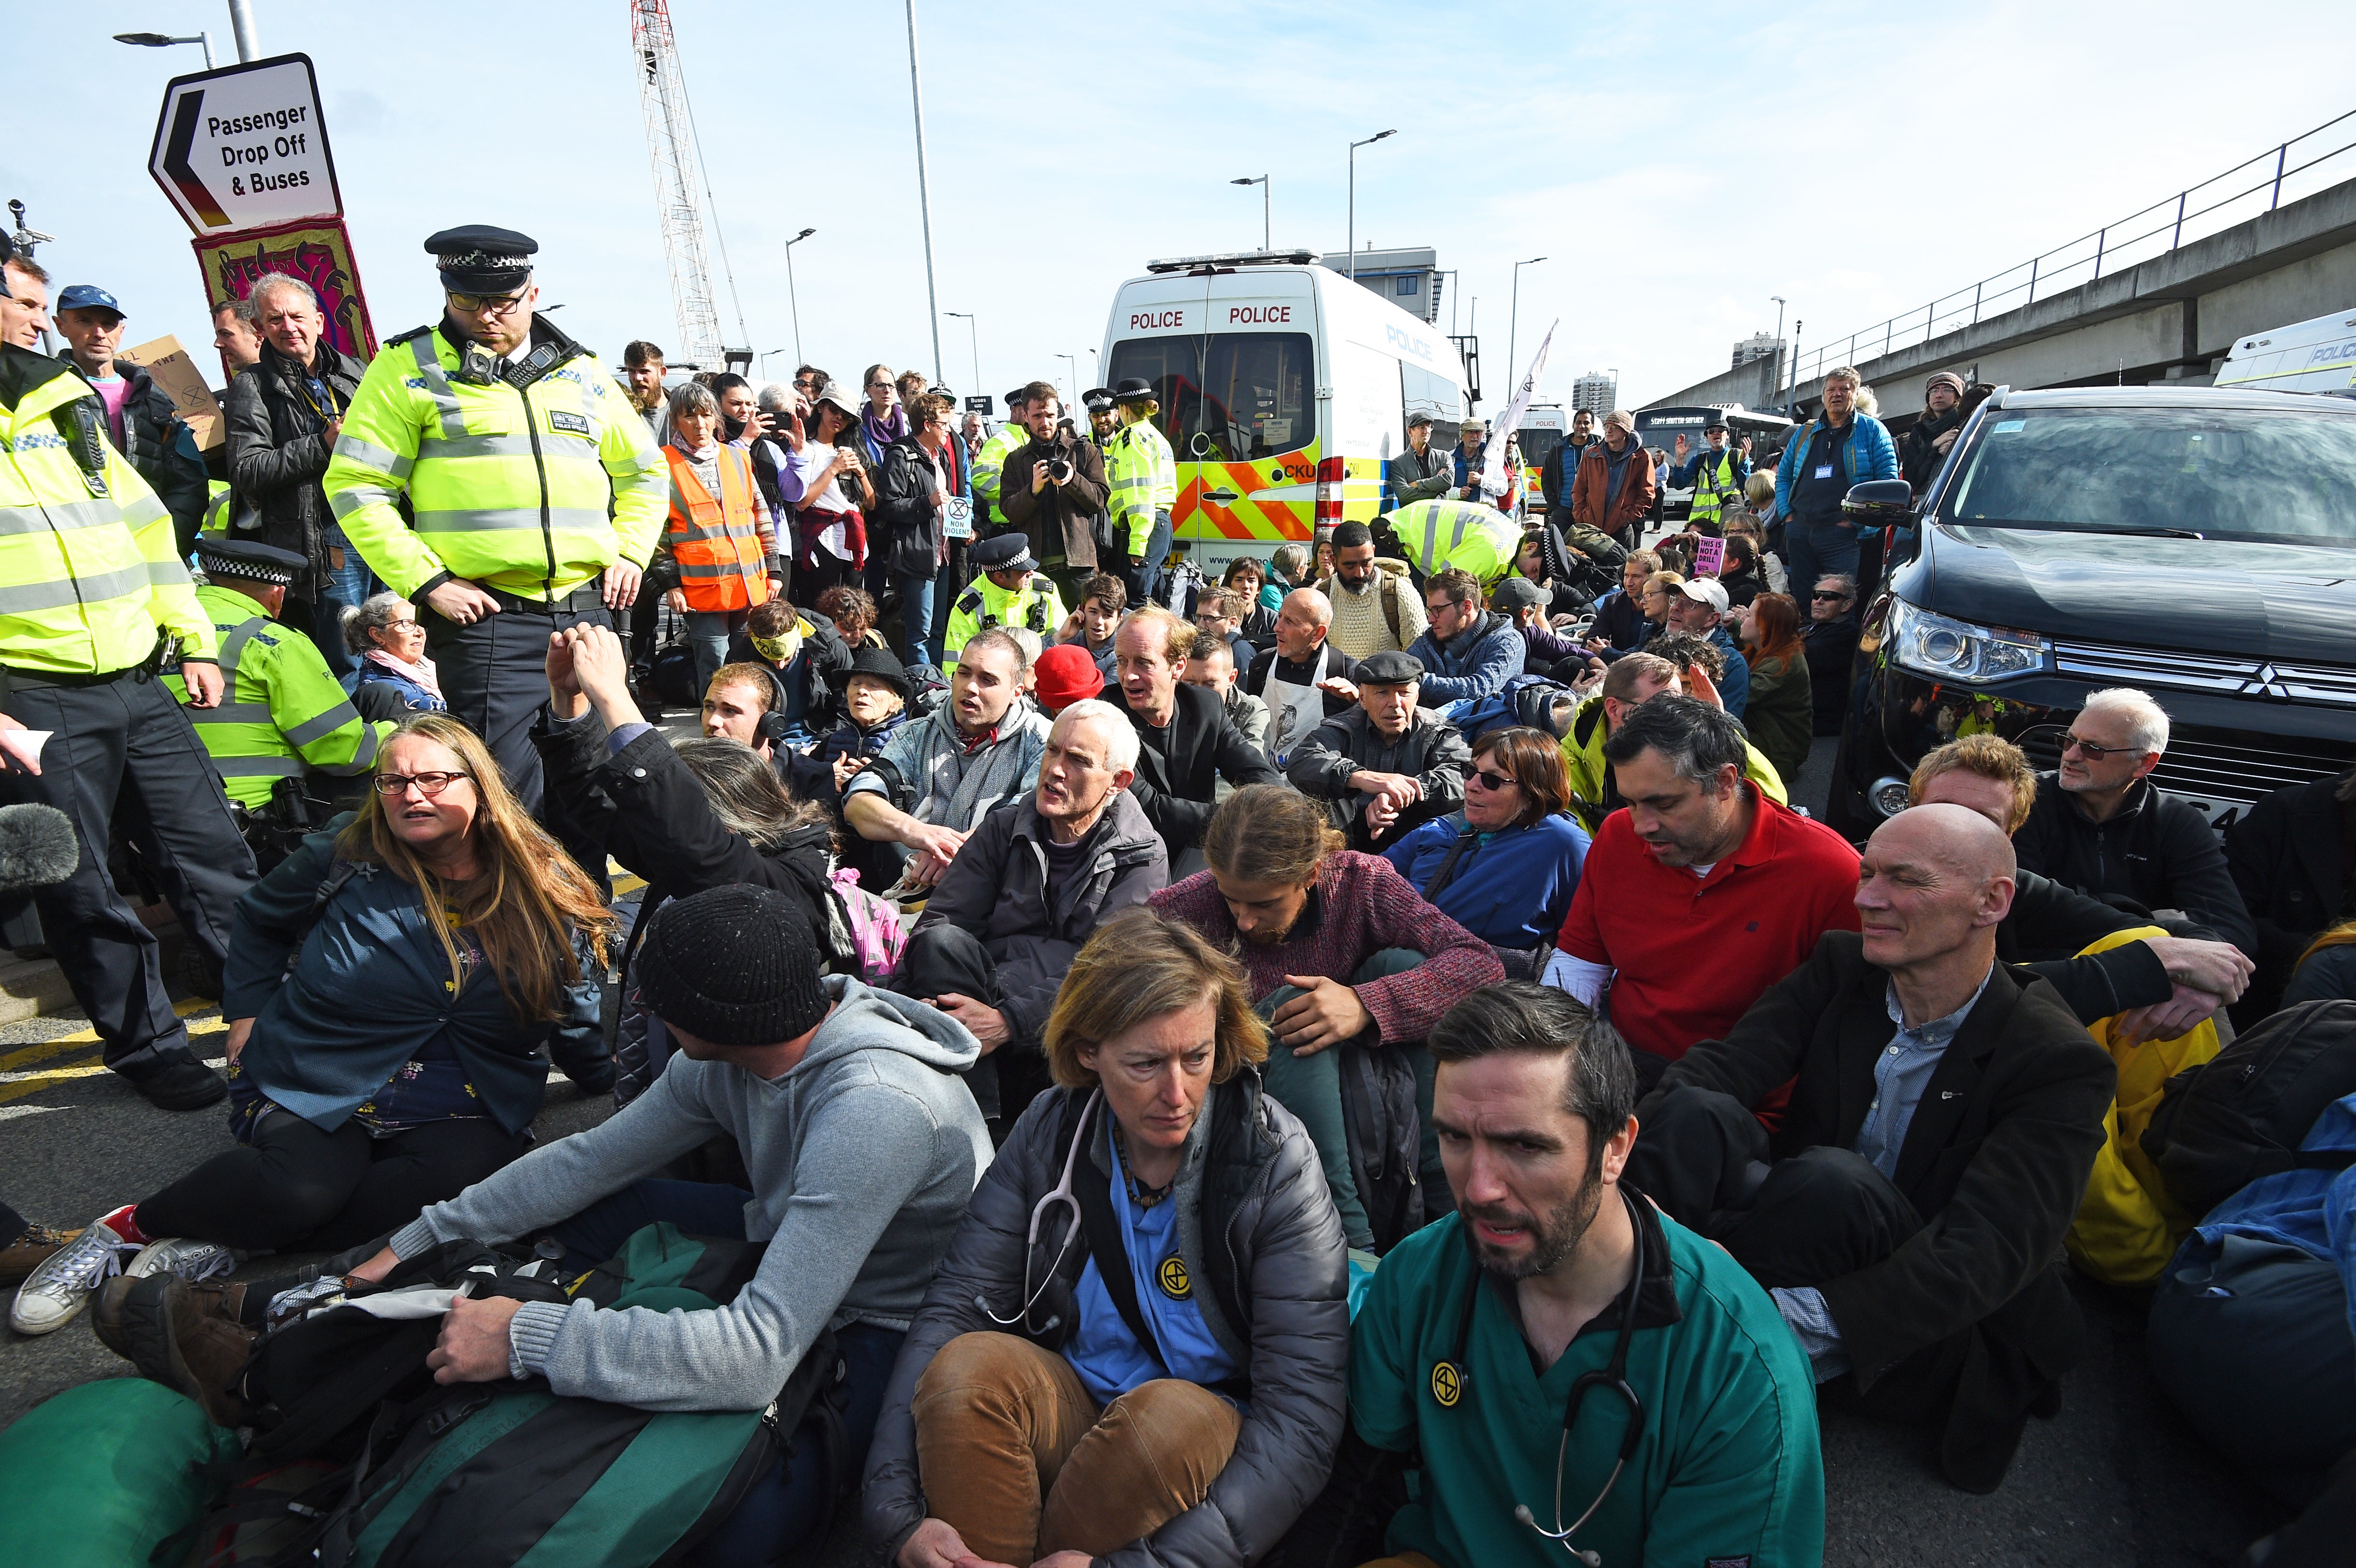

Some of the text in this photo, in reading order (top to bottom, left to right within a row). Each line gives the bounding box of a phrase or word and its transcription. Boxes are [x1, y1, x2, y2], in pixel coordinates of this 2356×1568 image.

[208, 106, 306, 138] Passenger
[221, 133, 305, 166] Drop Off
[233, 170, 310, 196] & Buses
[1131, 306, 1291, 330] POLICE POLICE
[1386, 324, 1433, 362] POLICE
[153, 354, 176, 367] THE
[1284, 464, 1317, 478] CKU
[944, 527, 970, 536] VIOLENT
[1700, 539, 1714, 548] THIS
